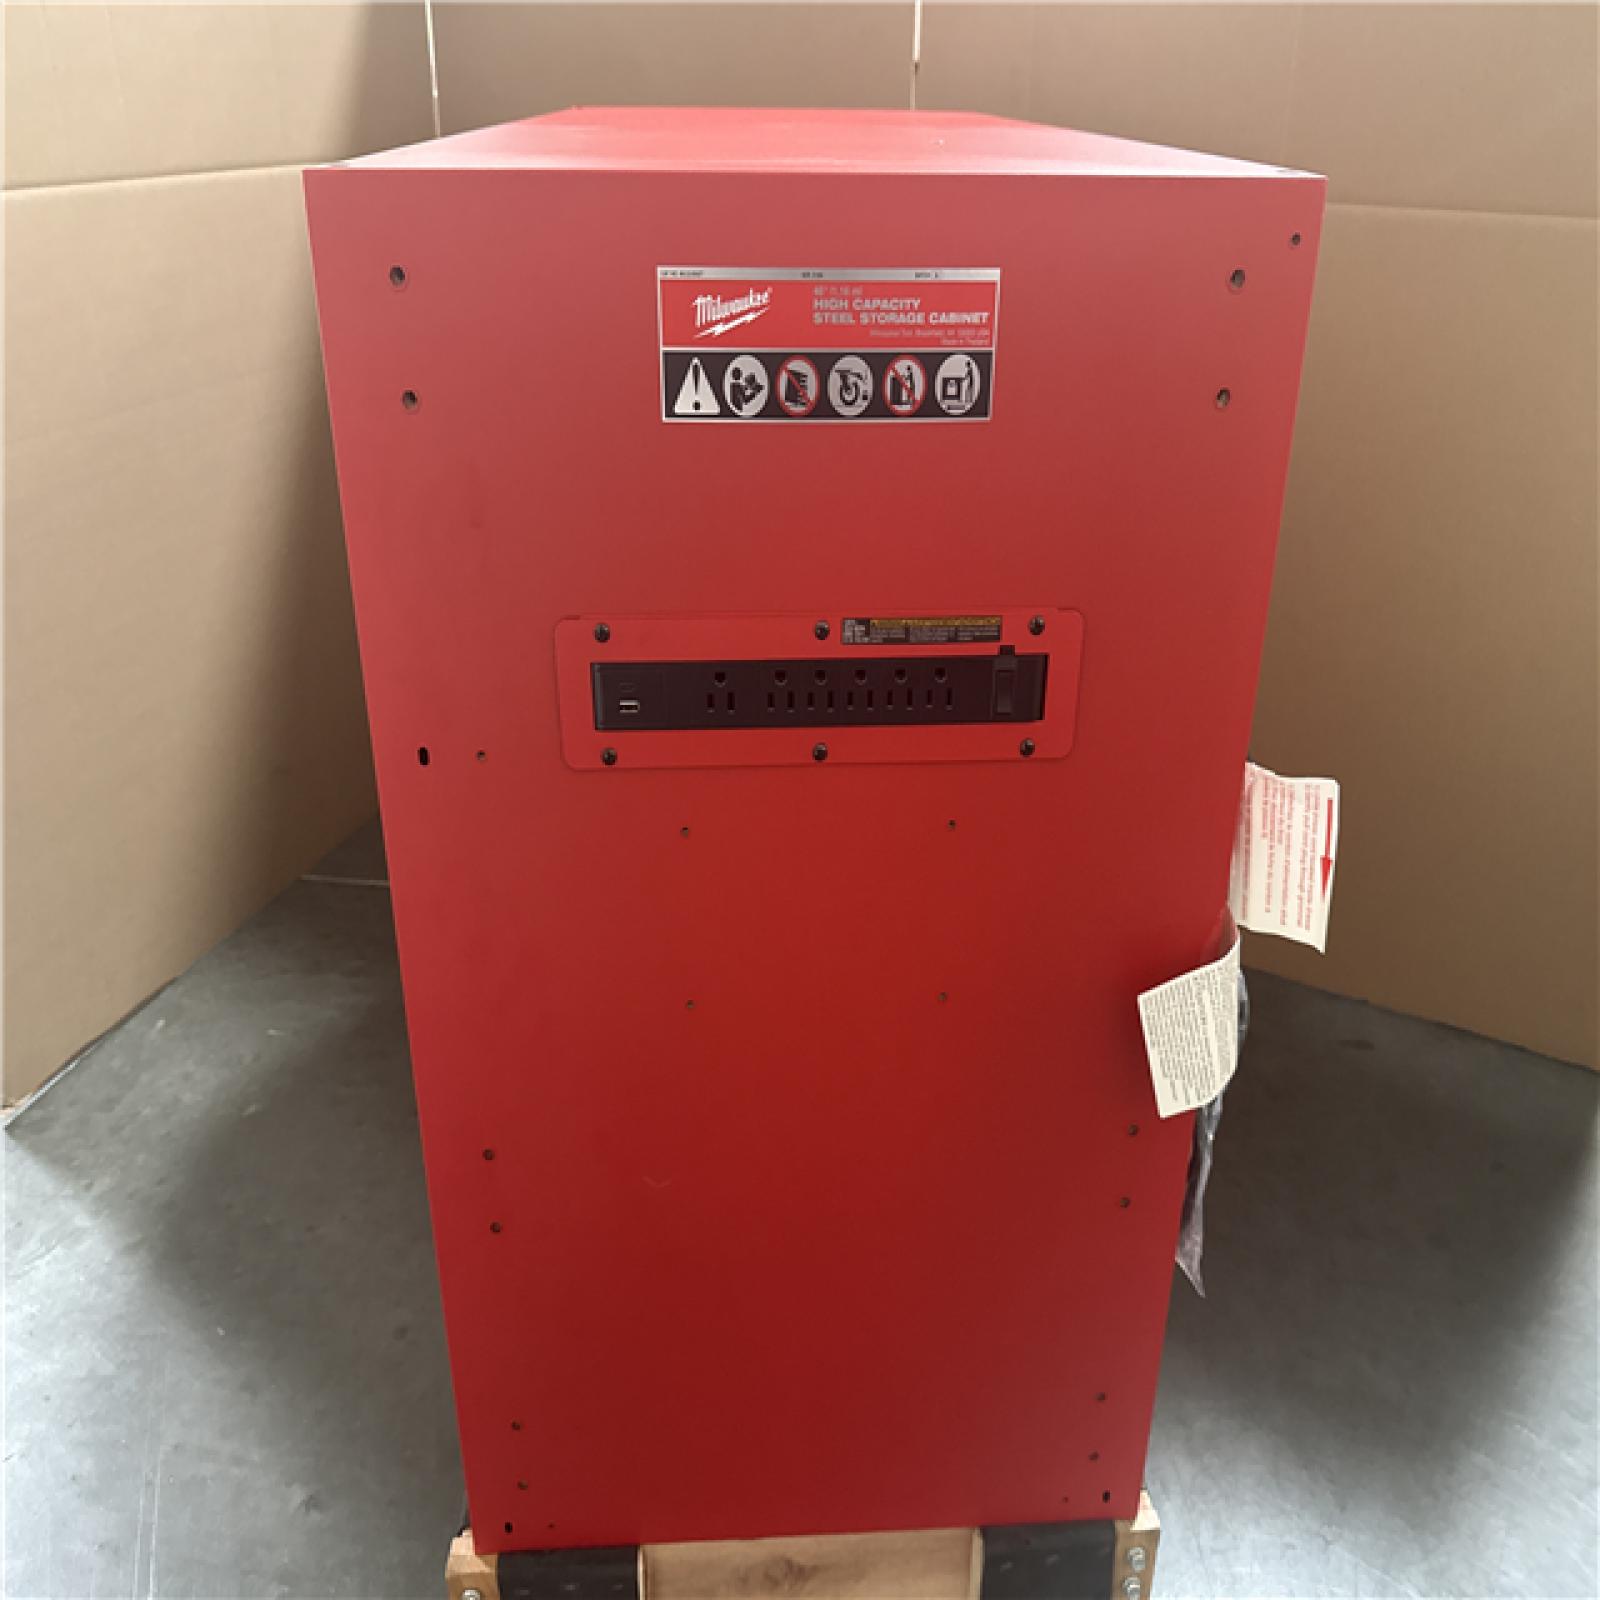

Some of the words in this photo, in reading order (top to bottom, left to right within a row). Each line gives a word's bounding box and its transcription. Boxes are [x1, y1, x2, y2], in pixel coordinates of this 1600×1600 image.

[692, 288, 772, 329] Milwaukee
[814, 298, 849, 311] HIGH
[852, 298, 921, 311] CAPACITY
[813, 312, 856, 325] STEEL
[859, 312, 926, 325] STORAGE
[929, 312, 990, 325] CABINET
